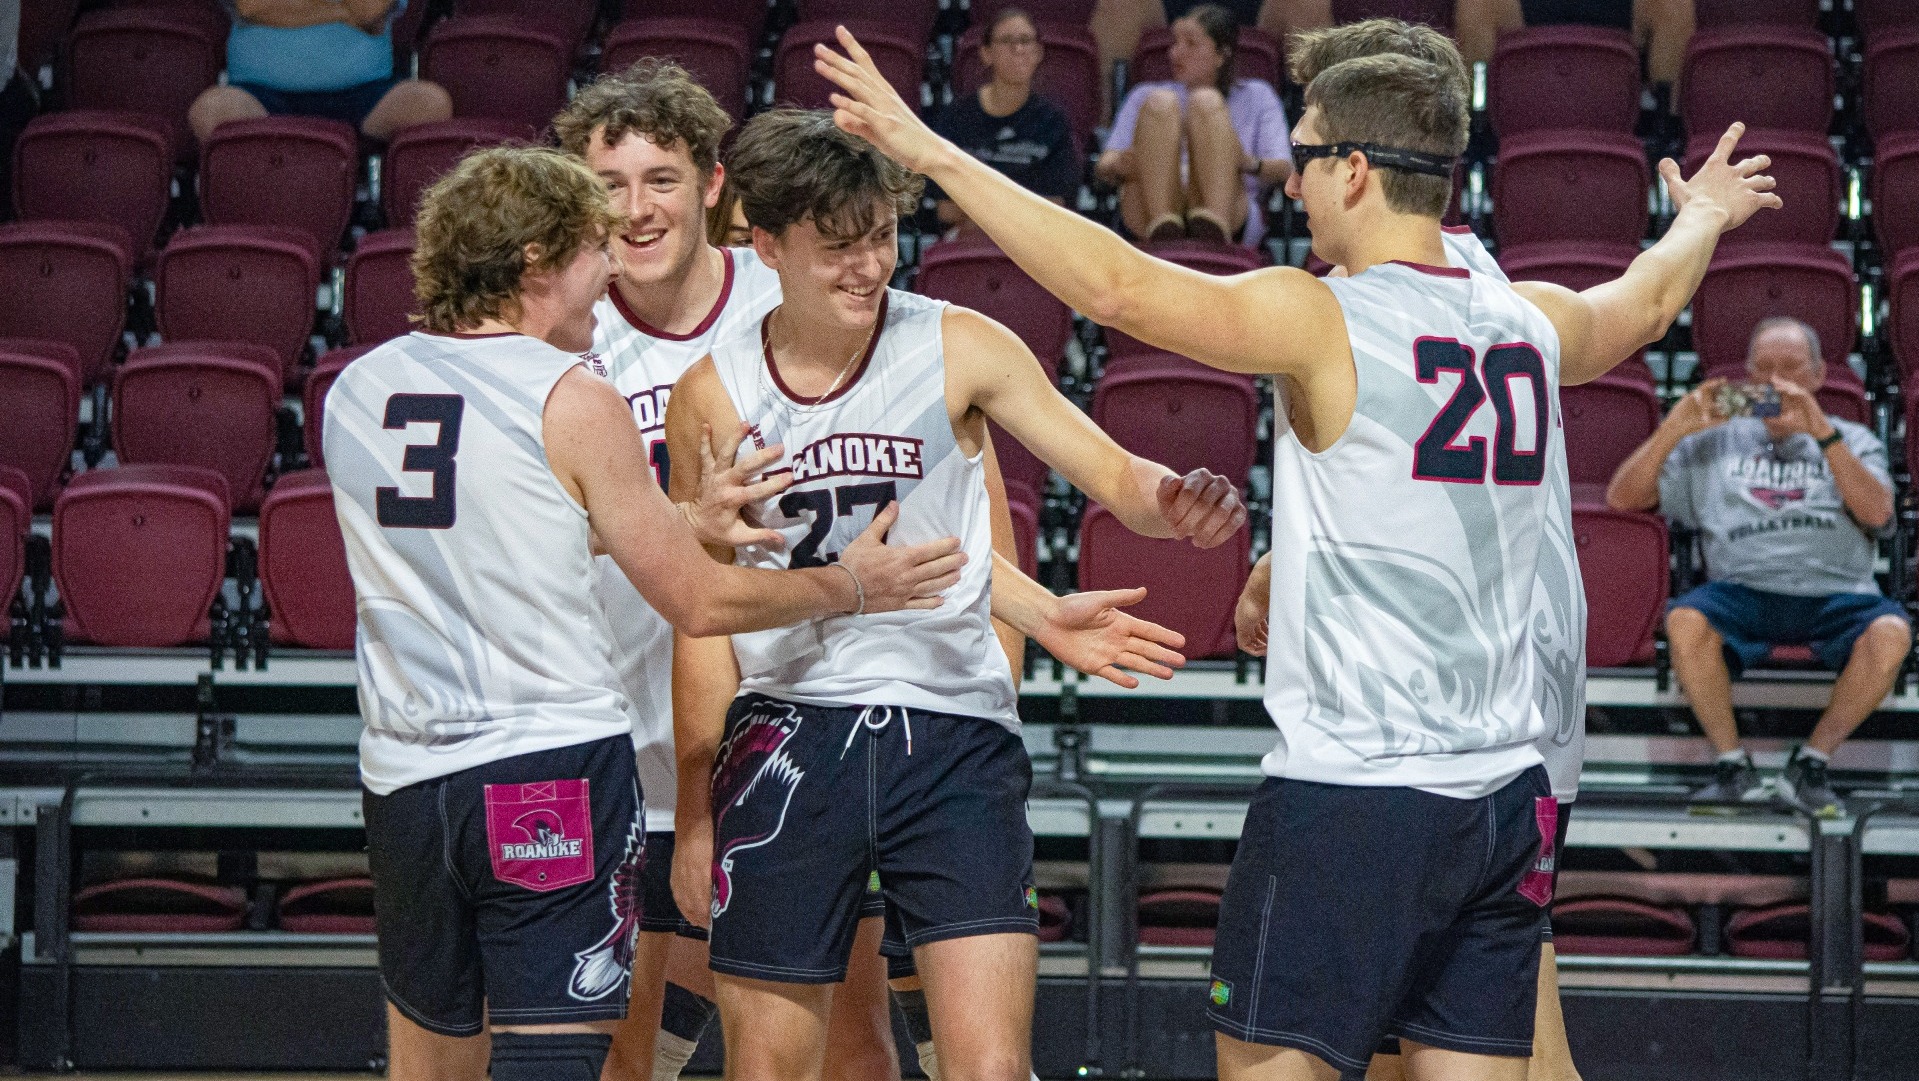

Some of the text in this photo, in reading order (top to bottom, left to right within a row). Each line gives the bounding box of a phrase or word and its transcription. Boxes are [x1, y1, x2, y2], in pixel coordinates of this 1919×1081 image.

[1412, 335, 1549, 486] 20
[376, 393, 465, 529] 3
[764, 433, 924, 488] ANOKE
[779, 481, 897, 570] 27
[502, 839, 582, 860] ROANOKE
